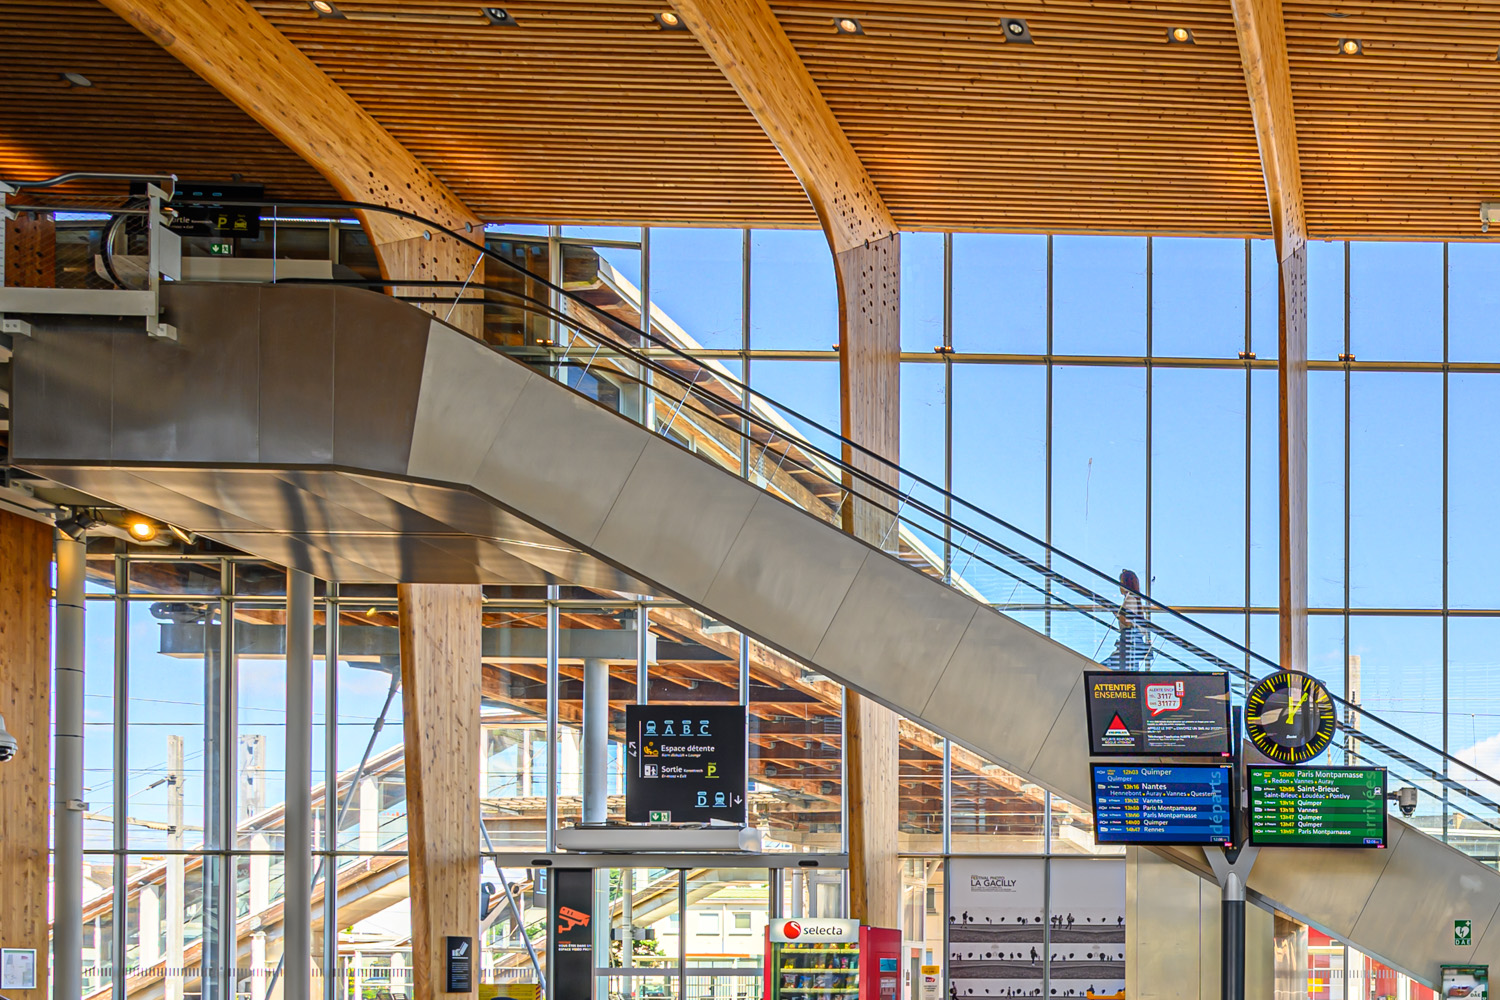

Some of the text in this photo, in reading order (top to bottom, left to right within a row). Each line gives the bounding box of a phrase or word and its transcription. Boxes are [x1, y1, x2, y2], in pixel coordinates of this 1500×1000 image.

[217, 217, 227, 228] P
[665, 725, 708, 734] A B C
[661, 744, 715, 753] Espace détente
[708, 766, 717, 776] P
[1141, 768, 1172, 776] Quimper
[1315, 771, 1363, 779] Montparnasse
[1297, 785, 1339, 793] Saint-Brieuc
[698, 796, 707, 806] D
[1209, 771, 1226, 834] départs
[1362, 771, 1376, 837] arrivées
[803, 926, 843, 935] selecta
